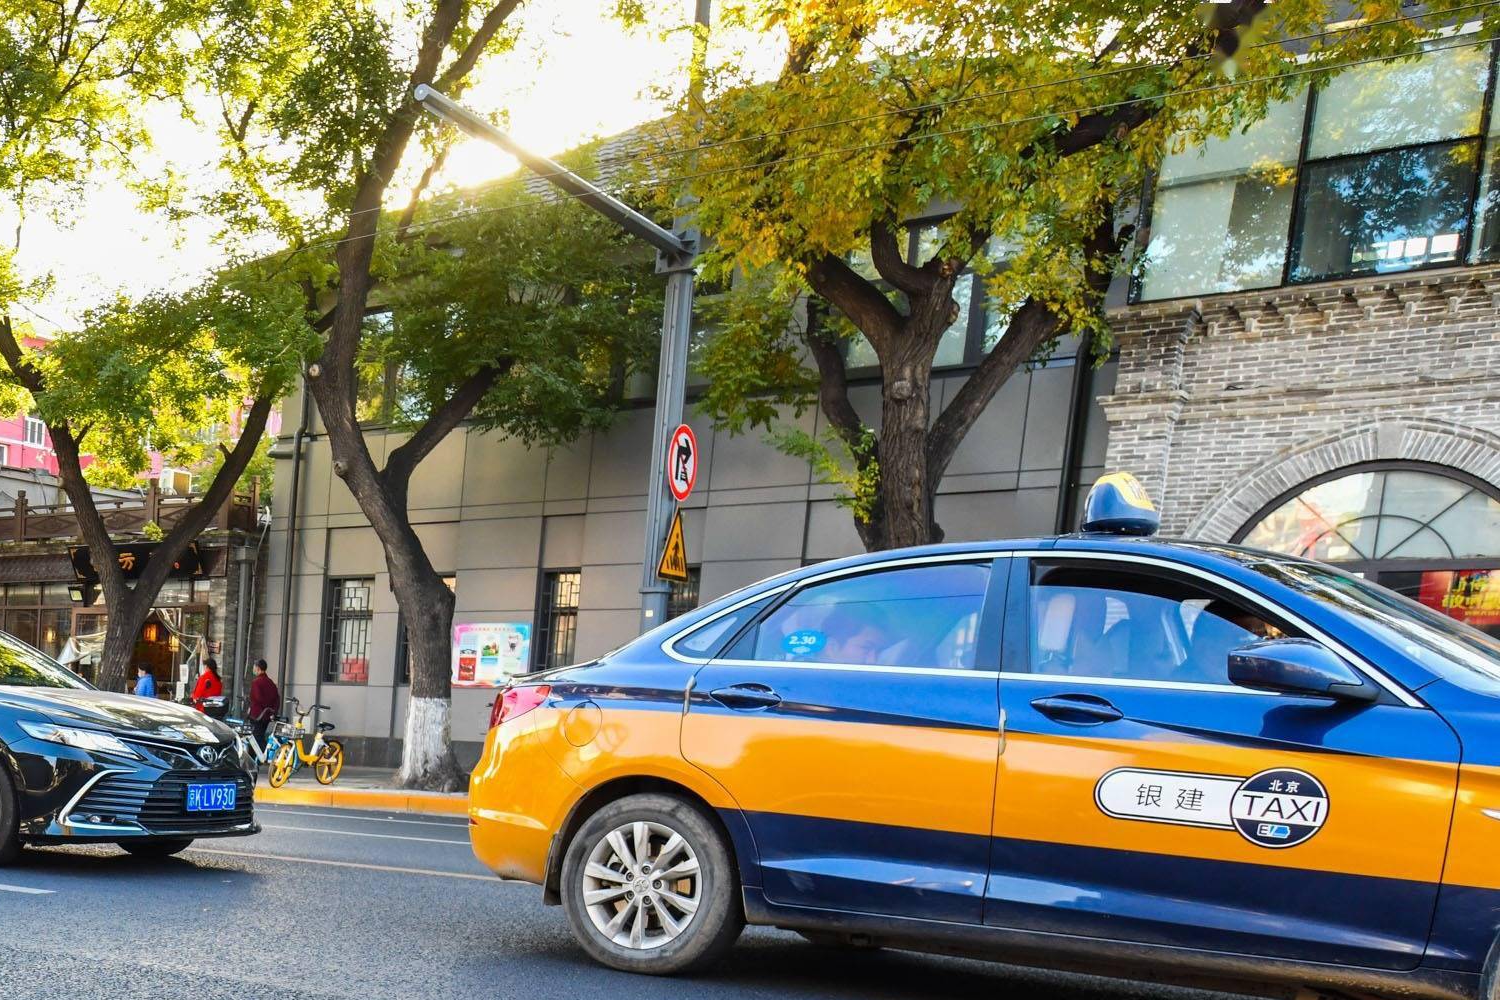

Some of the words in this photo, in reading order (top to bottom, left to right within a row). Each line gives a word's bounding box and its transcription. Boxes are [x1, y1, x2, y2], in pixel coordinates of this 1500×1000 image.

[788, 635, 816, 645] 2.30
[1268, 779, 1300, 793] 北京
[1136, 783, 1205, 811] 银建
[1242, 794, 1321, 822] TAXI
